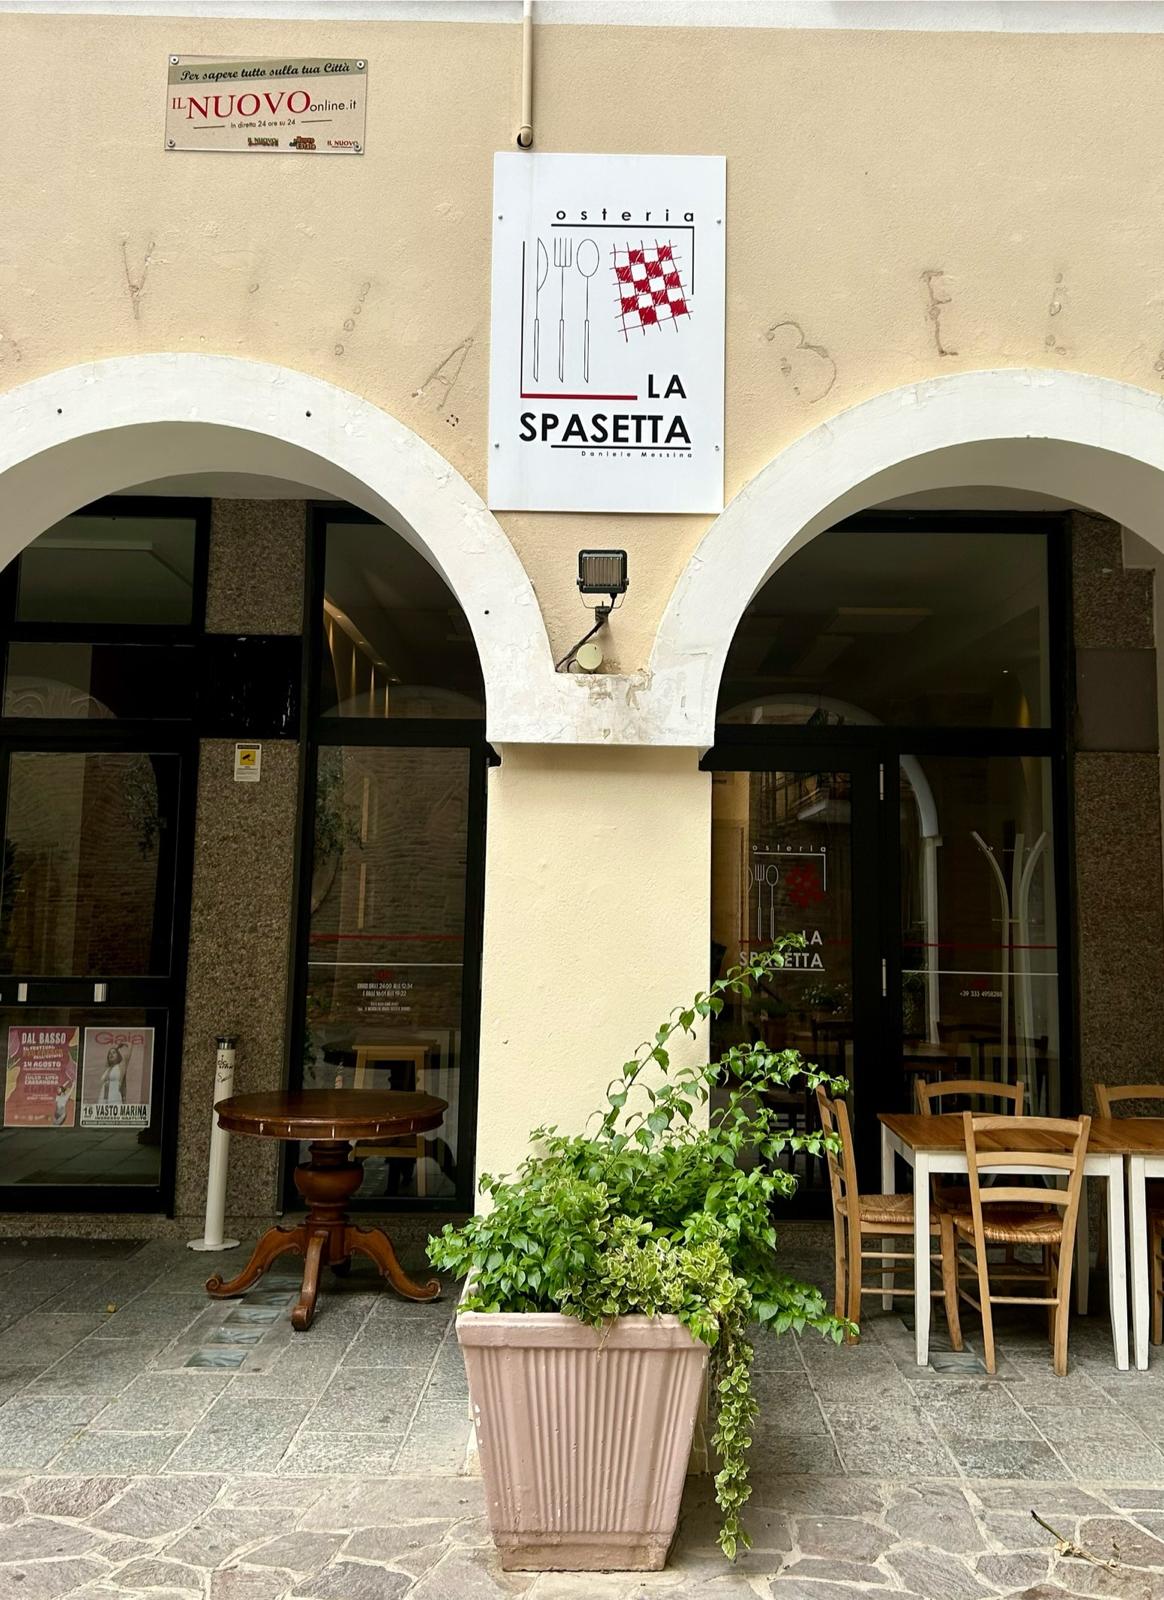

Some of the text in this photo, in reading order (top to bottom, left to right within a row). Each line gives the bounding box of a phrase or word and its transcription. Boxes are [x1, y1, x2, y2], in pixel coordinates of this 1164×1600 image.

[180, 62, 350, 82] Per sapere tutto sulla tua Città
[257, 120, 267, 128] 24
[287, 118, 296, 126] 24
[556, 208, 695, 222] osteria
[648, 374, 687, 399] LA
[518, 411, 692, 444] SPASETTA
[581, 450, 693, 459] Daniele Messina
[752, 843, 827, 853] osteria
[21, 1032, 66, 1044] DAL BASSO
[95, 1031, 144, 1045] Gaia
[96, 1105, 118, 1116] VASTO
[120, 1105, 147, 1116] MARINA
